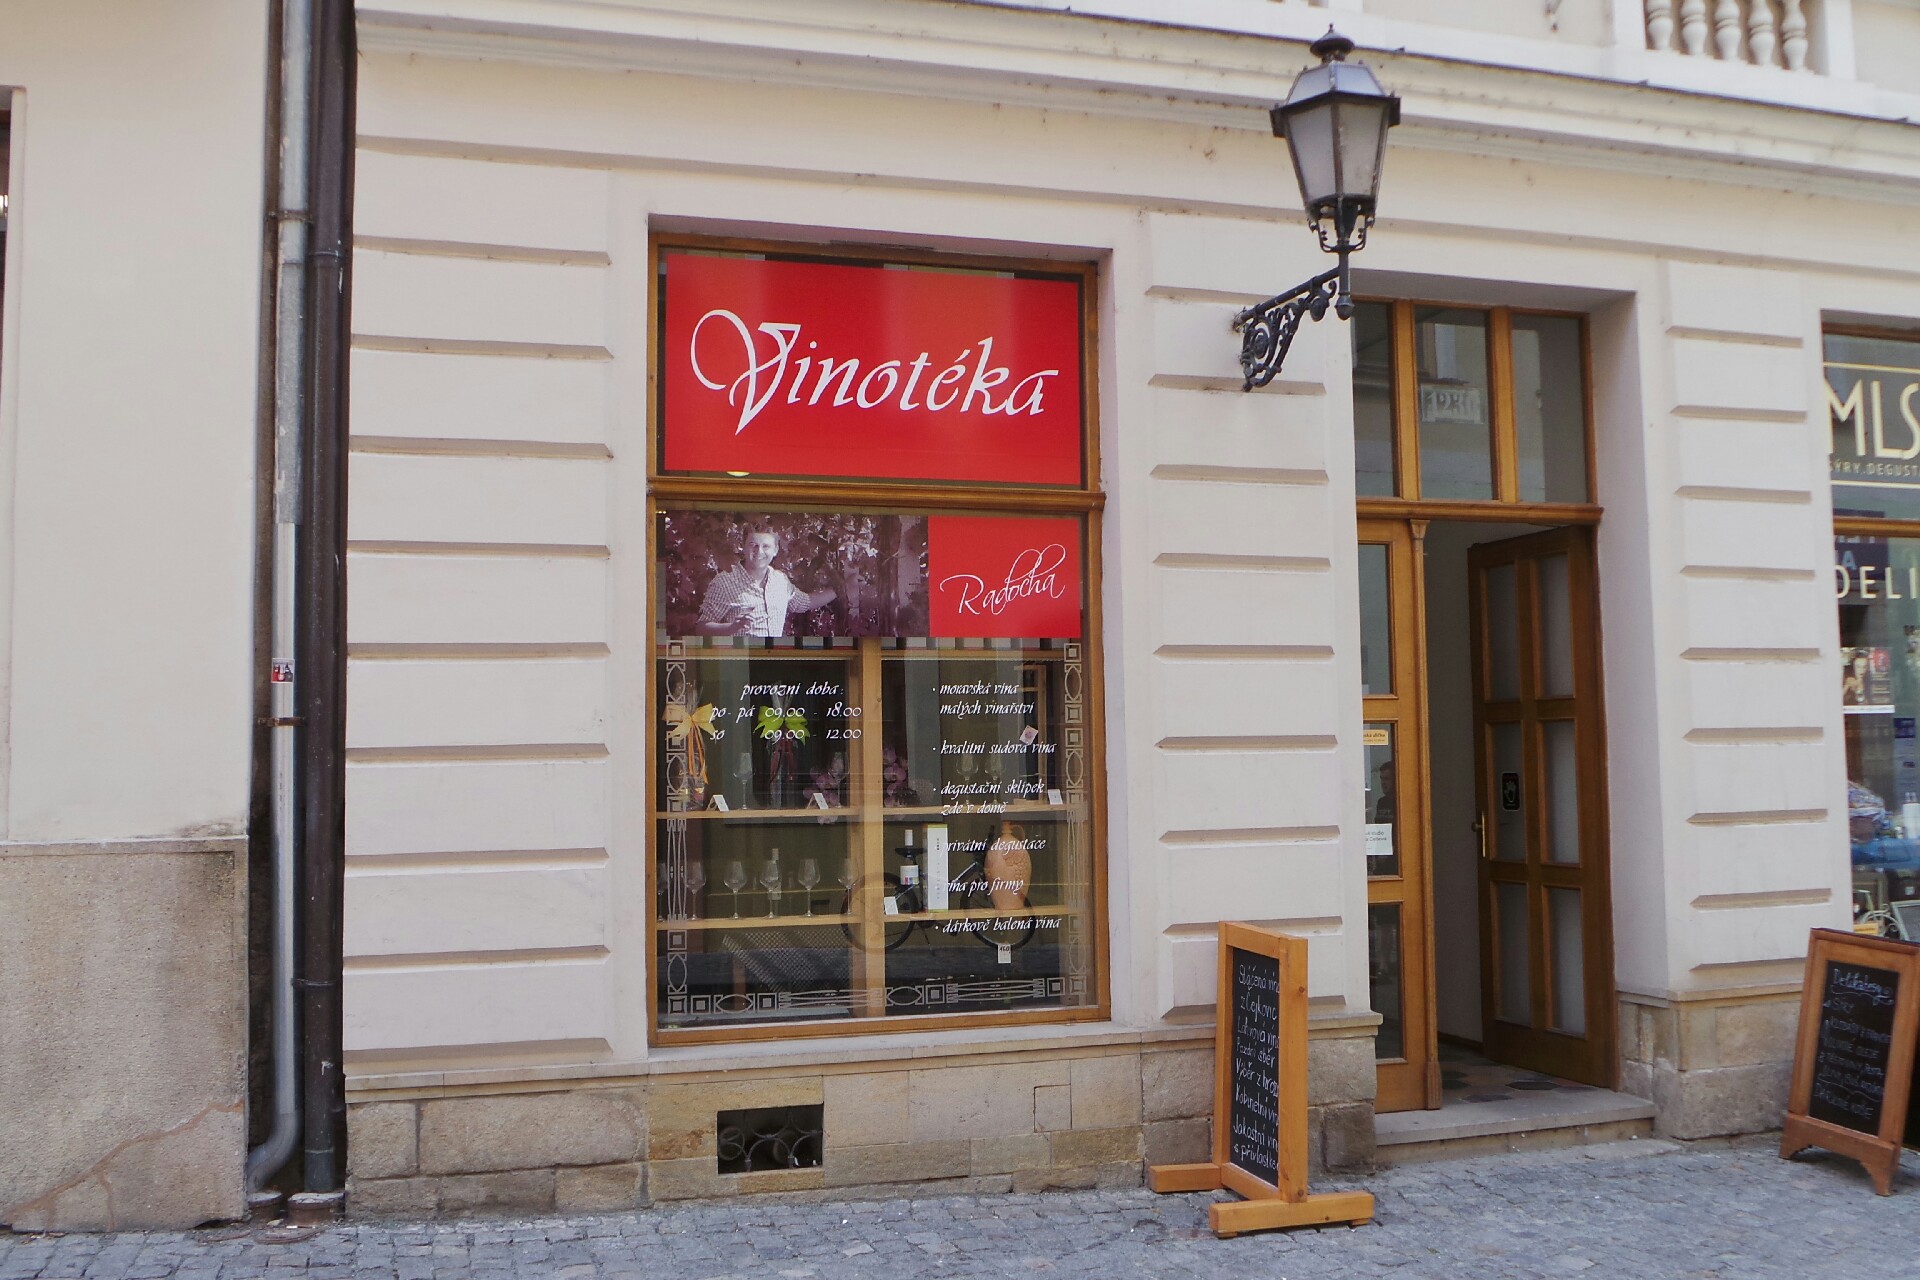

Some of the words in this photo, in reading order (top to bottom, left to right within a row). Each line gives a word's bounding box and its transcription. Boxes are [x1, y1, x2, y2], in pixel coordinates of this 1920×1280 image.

[690, 308, 1059, 436] Vinotéka
[940, 543, 1067, 616] Radocha
[1834, 564, 1918, 600] DELI
[939, 679, 992, 695] moravská
[993, 682, 1020, 695] vína
[735, 704, 756, 724] pá
[764, 706, 806, 723] 09.00
[825, 701, 862, 717] 18.00
[939, 699, 982, 720] malých
[984, 701, 1035, 715] vinařství
[709, 729, 726, 744] so
[764, 728, 805, 745] 09.00
[825, 728, 862, 740] 12.00
[940, 780, 1002, 800] degustační
[1004, 778, 1045, 798] sklípek
[940, 800, 963, 816] zde
[965, 804, 975, 814] v
[976, 799, 1008, 814] domě
[990, 837, 1047, 856] degustace
[967, 879, 989, 897] pro
[987, 876, 1024, 896] firmy
[942, 917, 992, 934] dárkově
[992, 916, 1031, 931] balená
[1034, 916, 1062, 929] vína
[1241, 1144, 1279, 1172] přívlastke
